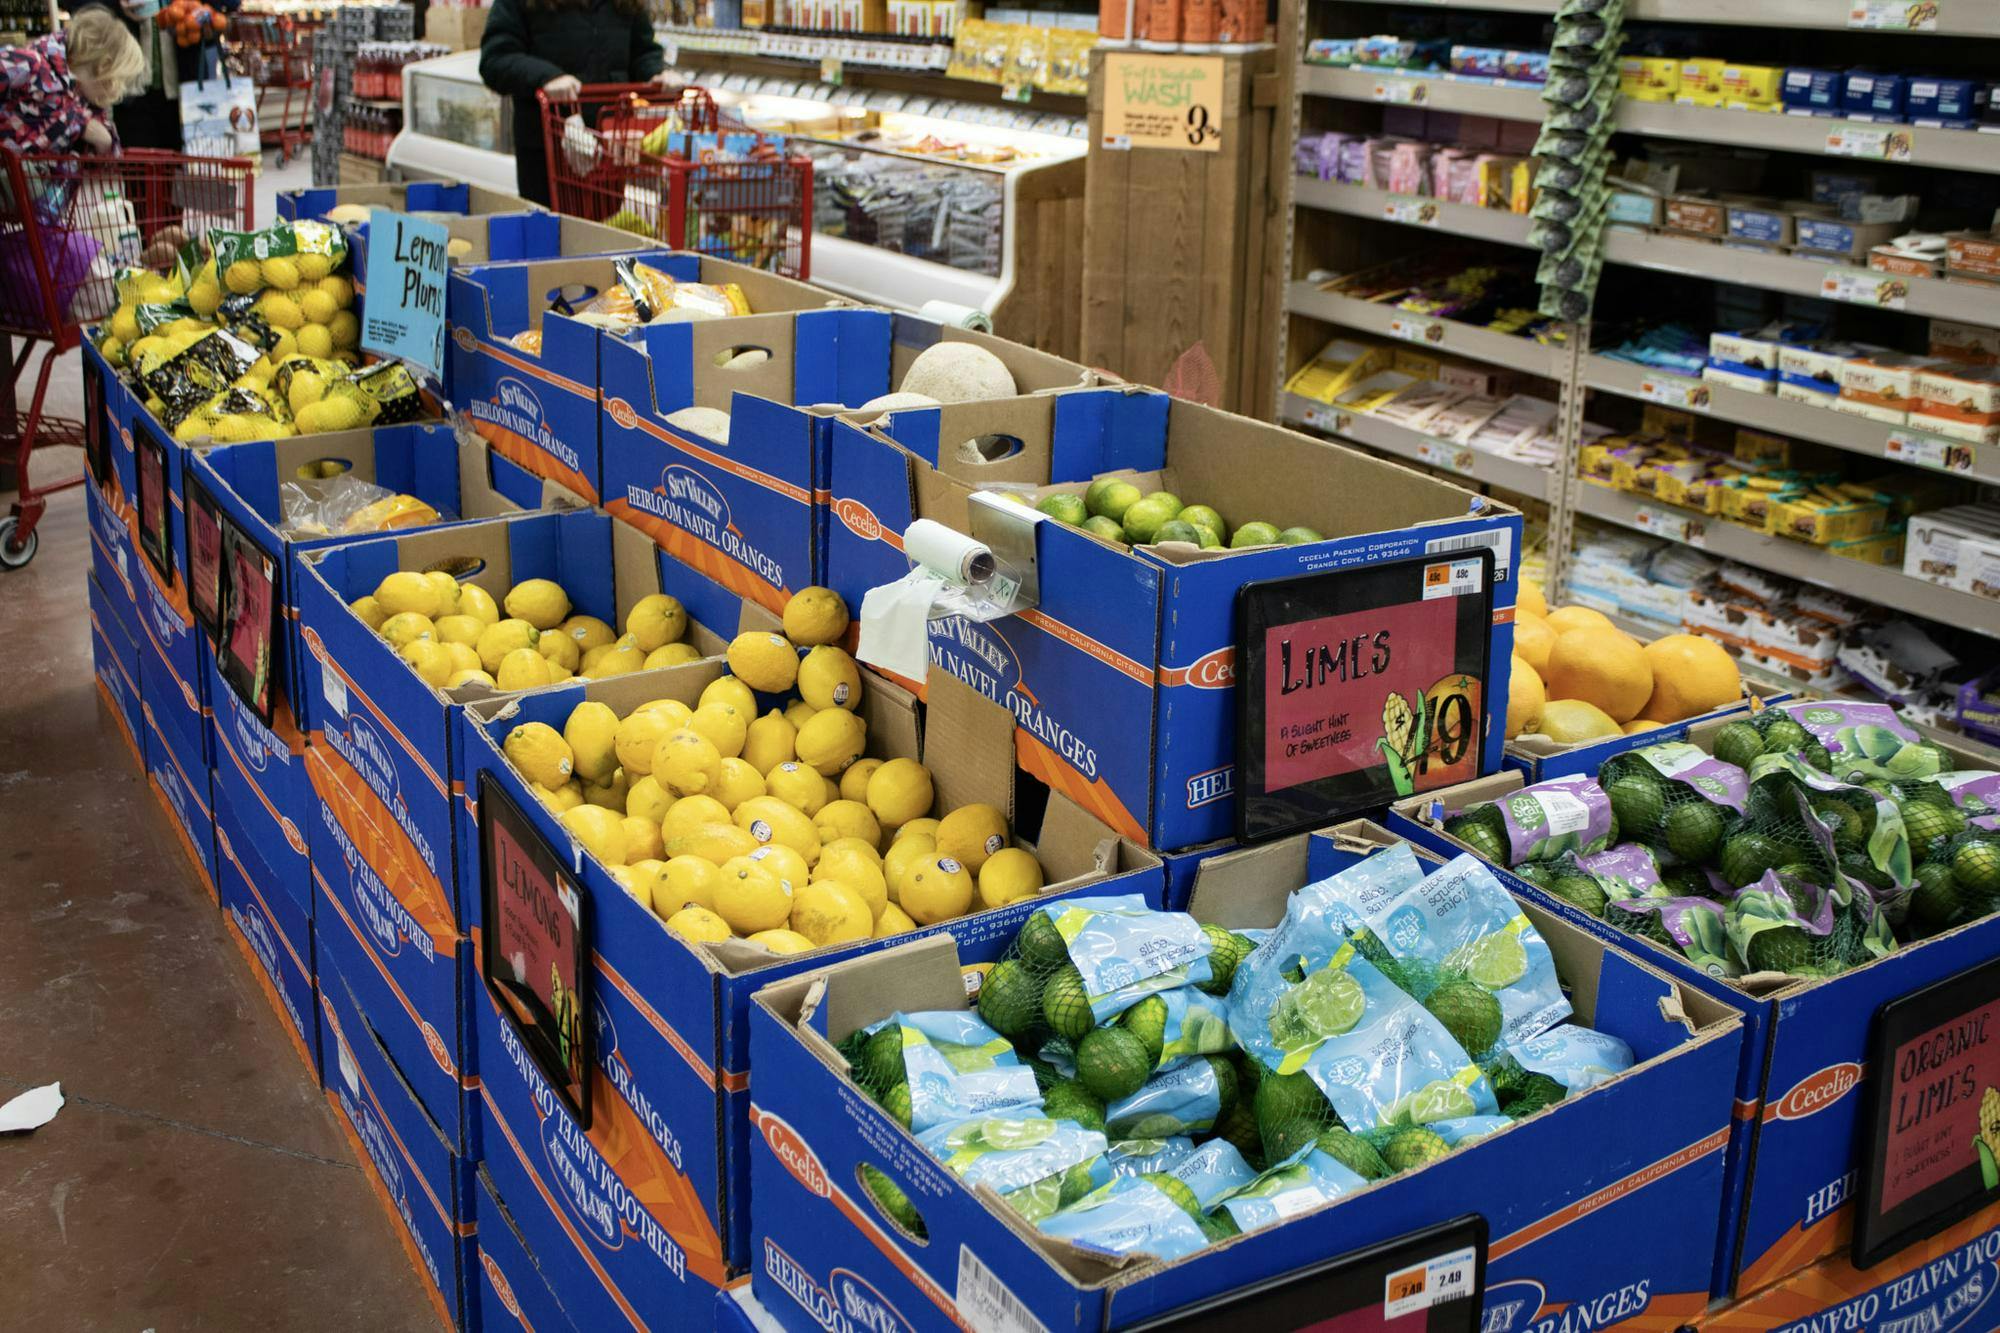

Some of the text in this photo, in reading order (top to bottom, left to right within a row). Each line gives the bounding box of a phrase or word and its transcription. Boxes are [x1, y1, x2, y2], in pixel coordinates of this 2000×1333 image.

[1123, 80, 1192, 107] WASH
[395, 220, 445, 276] Lemon
[400, 267, 444, 318] Plums
[470, 399, 579, 471] HEIRLOOM NAVEL ORANGES
[613, 402, 635, 427] Cecelia
[627, 484, 783, 587] HEIRLOOM NAVEL ORANGES
[843, 507, 878, 538] Cecelia
[1298, 538, 1420, 563] CECELIA PACKING CORPORATION
[1307, 547, 1411, 571] ORANGE COVE, CA 93646
[1035, 615, 1145, 679] PREMIUM CALIFORNIA CITRUS
[1281, 629, 1391, 695] LIMES
[1006, 690, 1097, 777] ORANGES
[1286, 729, 1352, 757] OF SWEETNESS
[1291, 718, 1325, 738] SLIGHT
[1328, 712, 1351, 730] HINT
[323, 719, 367, 775] HEIRLOOM
[366, 757, 393, 811] NAVEL
[393, 797, 437, 873] ORANGES
[321, 801, 434, 963] HEIRLOOM NAVEL ORANGES
[500, 836, 561, 949] LEMONS
[1492, 869, 1621, 942] CECELIA PACKING CORPORATION
[883, 903, 1036, 948] CECELIA PACKING CORPORATION
[964, 930, 1008, 946] OF U.S.A.
[971, 926, 985, 935] CA
[989, 915, 1025, 930] 93646
[1395, 911, 1418, 929] Tru
[1395, 922, 1421, 947] Star
[501, 1017, 553, 1117] ORANGES
[1901, 1012, 1991, 1083] ORGANIC
[606, 1054, 682, 1169] ORANGES
[1790, 1067, 1854, 1112] Cecelia
[1896, 1064, 1976, 1135] LIMES
[555, 1104, 600, 1181] NAVEL
[769, 1125, 824, 1194] Cecelia
[857, 1126, 892, 1161] PRODUCT
[1577, 1135, 1725, 1214] PREMIUM CALIFORNIA CITRUS
[600, 1168, 686, 1283] HEIRLOOM
[911, 1271, 956, 1317] PREMIUM
[1886, 1252, 1961, 1311] NAVEL
